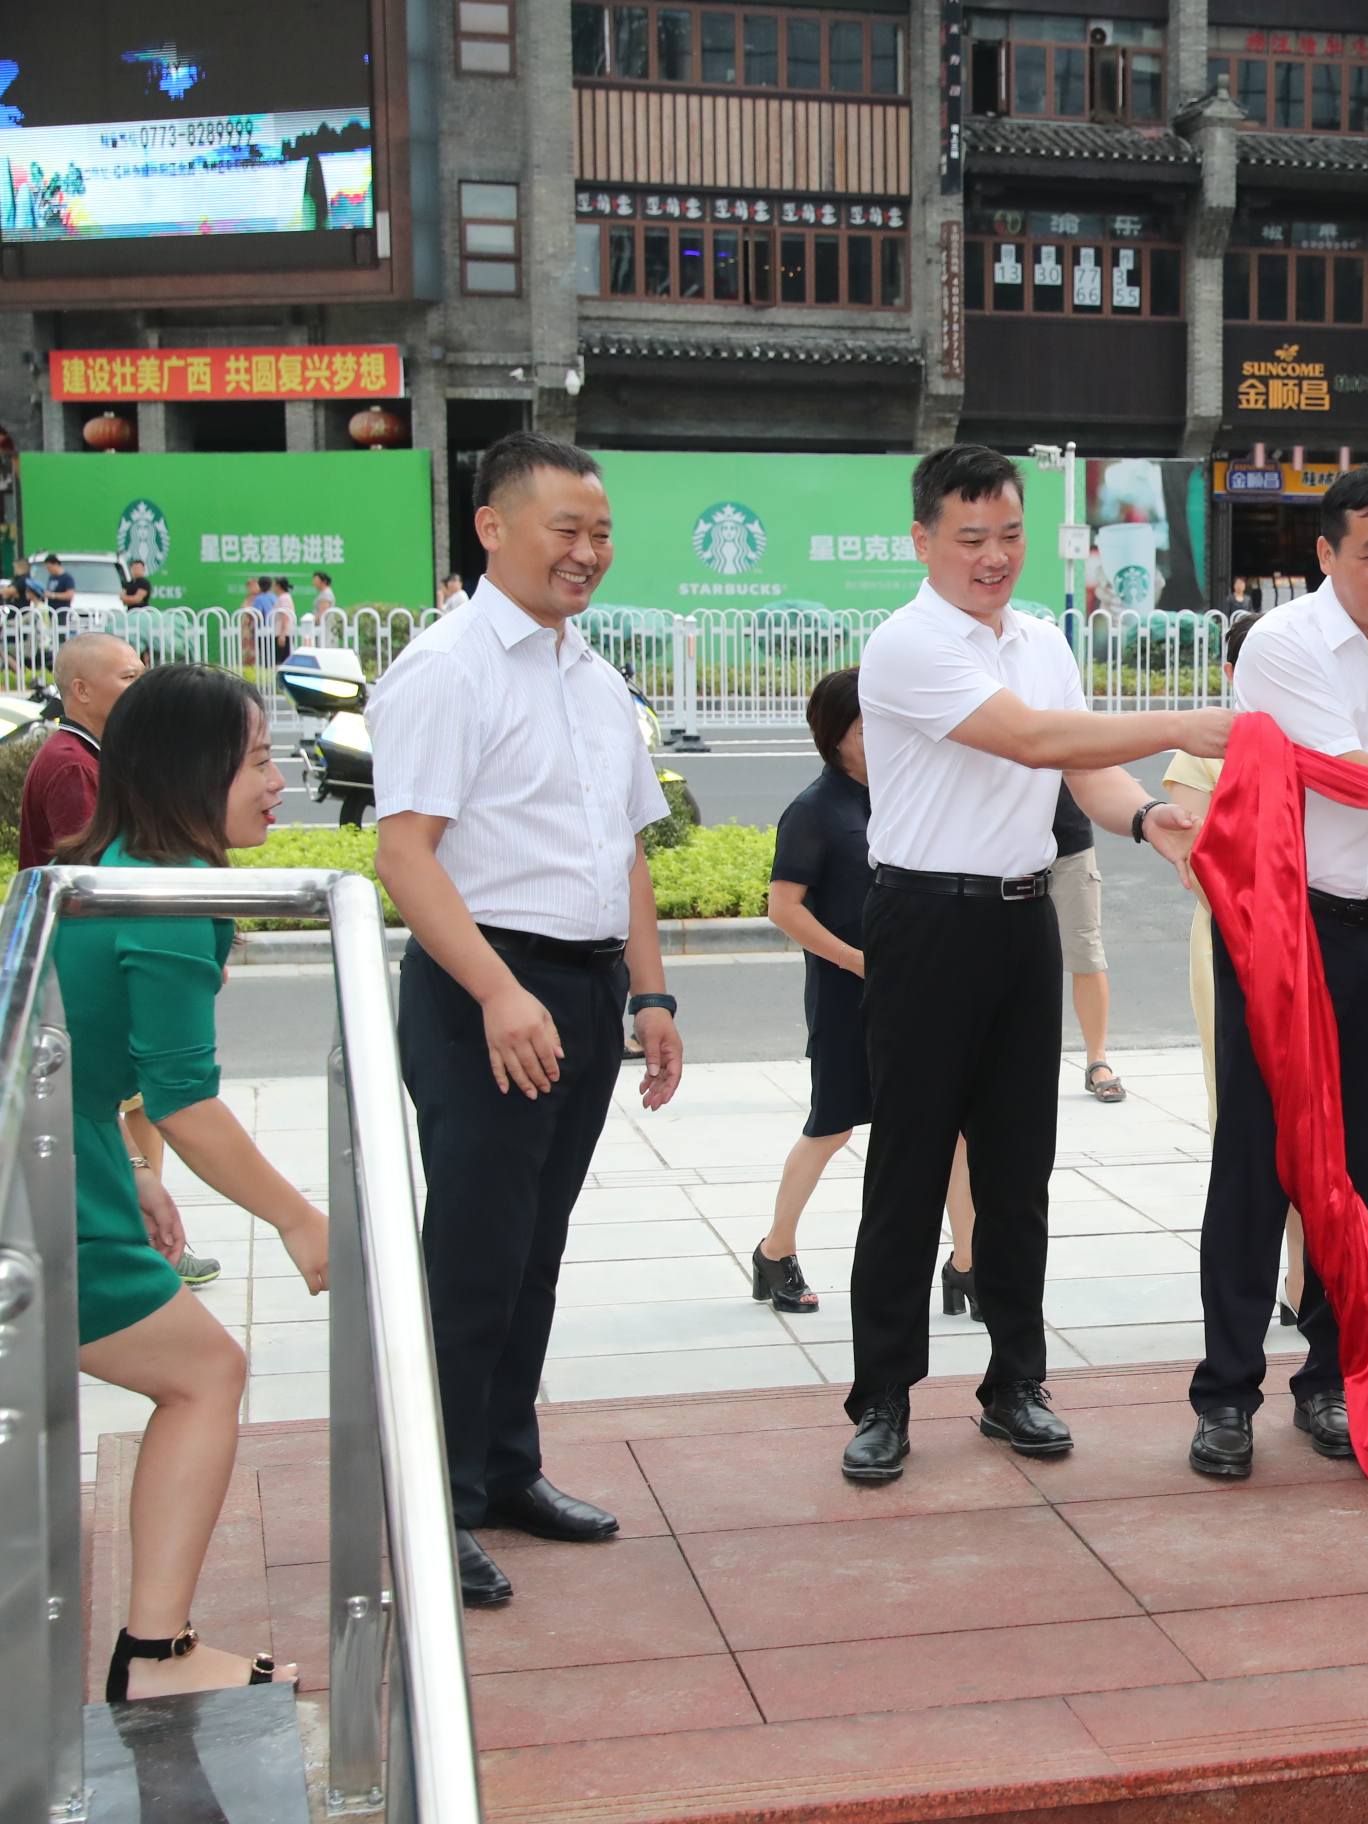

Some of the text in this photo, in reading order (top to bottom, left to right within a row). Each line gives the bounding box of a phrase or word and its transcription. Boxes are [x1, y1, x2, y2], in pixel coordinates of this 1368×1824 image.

[998, 265, 1019, 280] 13
[1036, 266, 1060, 283] 30
[1077, 269, 1098, 283] 77
[1076, 286, 1138, 304] 66 55
[61, 352, 387, 395] 建设壮美广西 共圆复兴梦想
[1242, 361, 1325, 378] SUNCOME
[1238, 378, 1331, 411] 金顺昌
[1231, 472, 1280, 490] 金顺昌
[201, 533, 345, 564] 星巴克强势进驻
[678, 583, 782, 597] STARBUCKS
